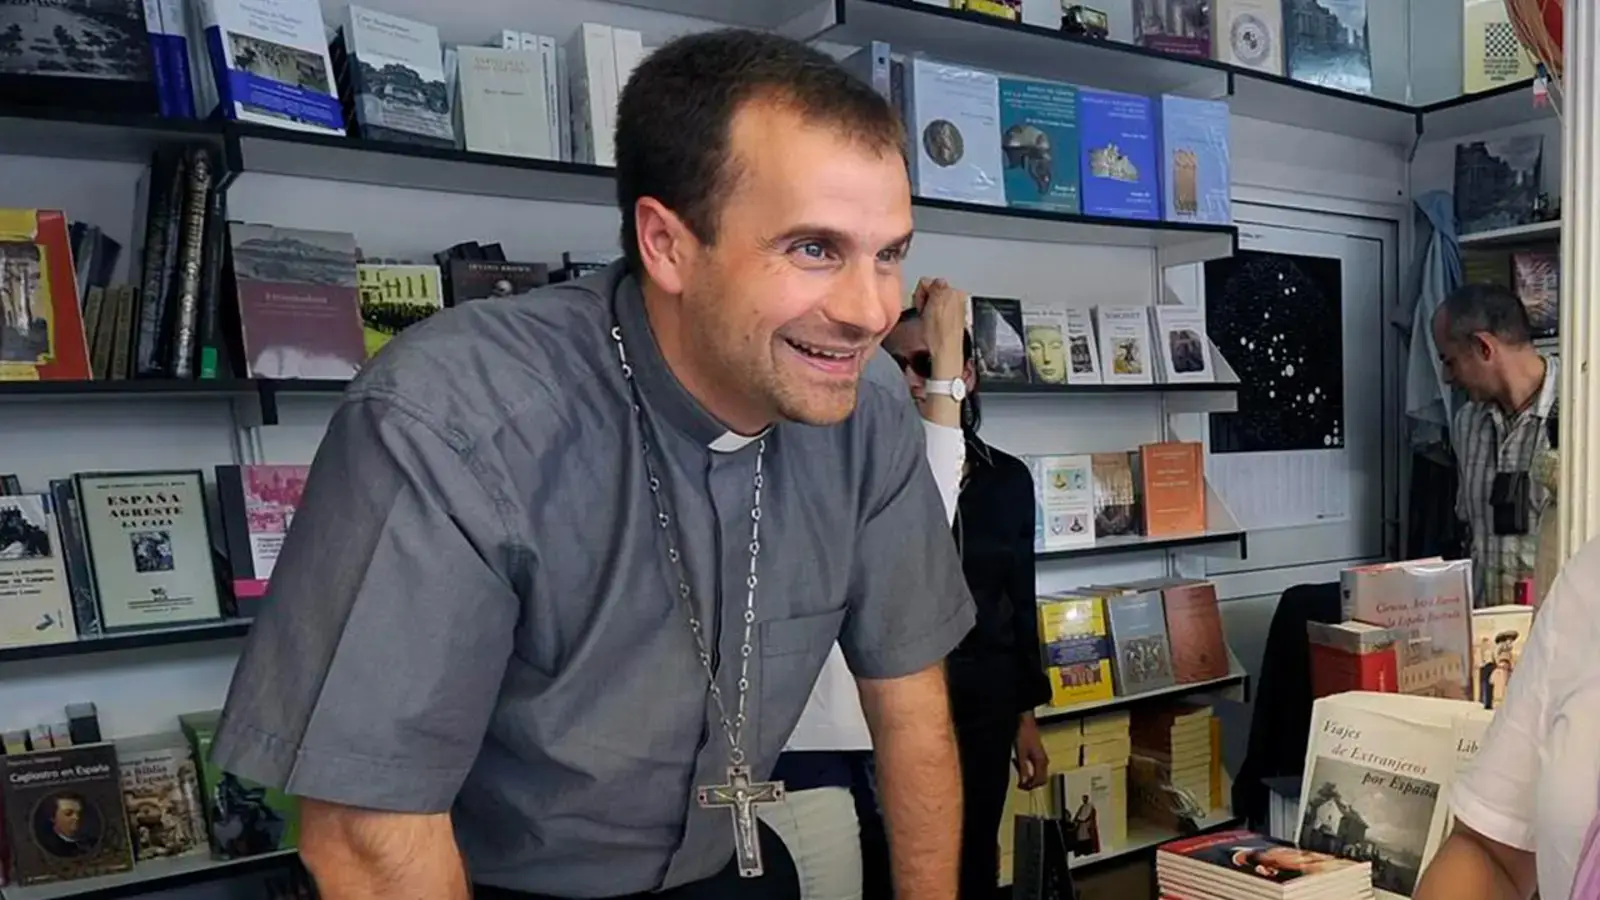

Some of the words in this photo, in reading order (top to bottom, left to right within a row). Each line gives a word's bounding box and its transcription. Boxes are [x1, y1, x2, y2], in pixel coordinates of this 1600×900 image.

[107, 492, 181, 506] ESPAÑA
[108, 507, 184, 518] AGRESTE
[142, 519, 173, 527] CAZA
[1323, 720, 1361, 739] Viajes
[1331, 743, 1348, 756] de
[1350, 746, 1428, 776] Extranjeros
[10, 769, 60, 784] Cagliostro
[60, 767, 74, 776] en
[75, 764, 111, 777] España
[1361, 771, 1386, 785] por
[1389, 775, 1438, 798] España
